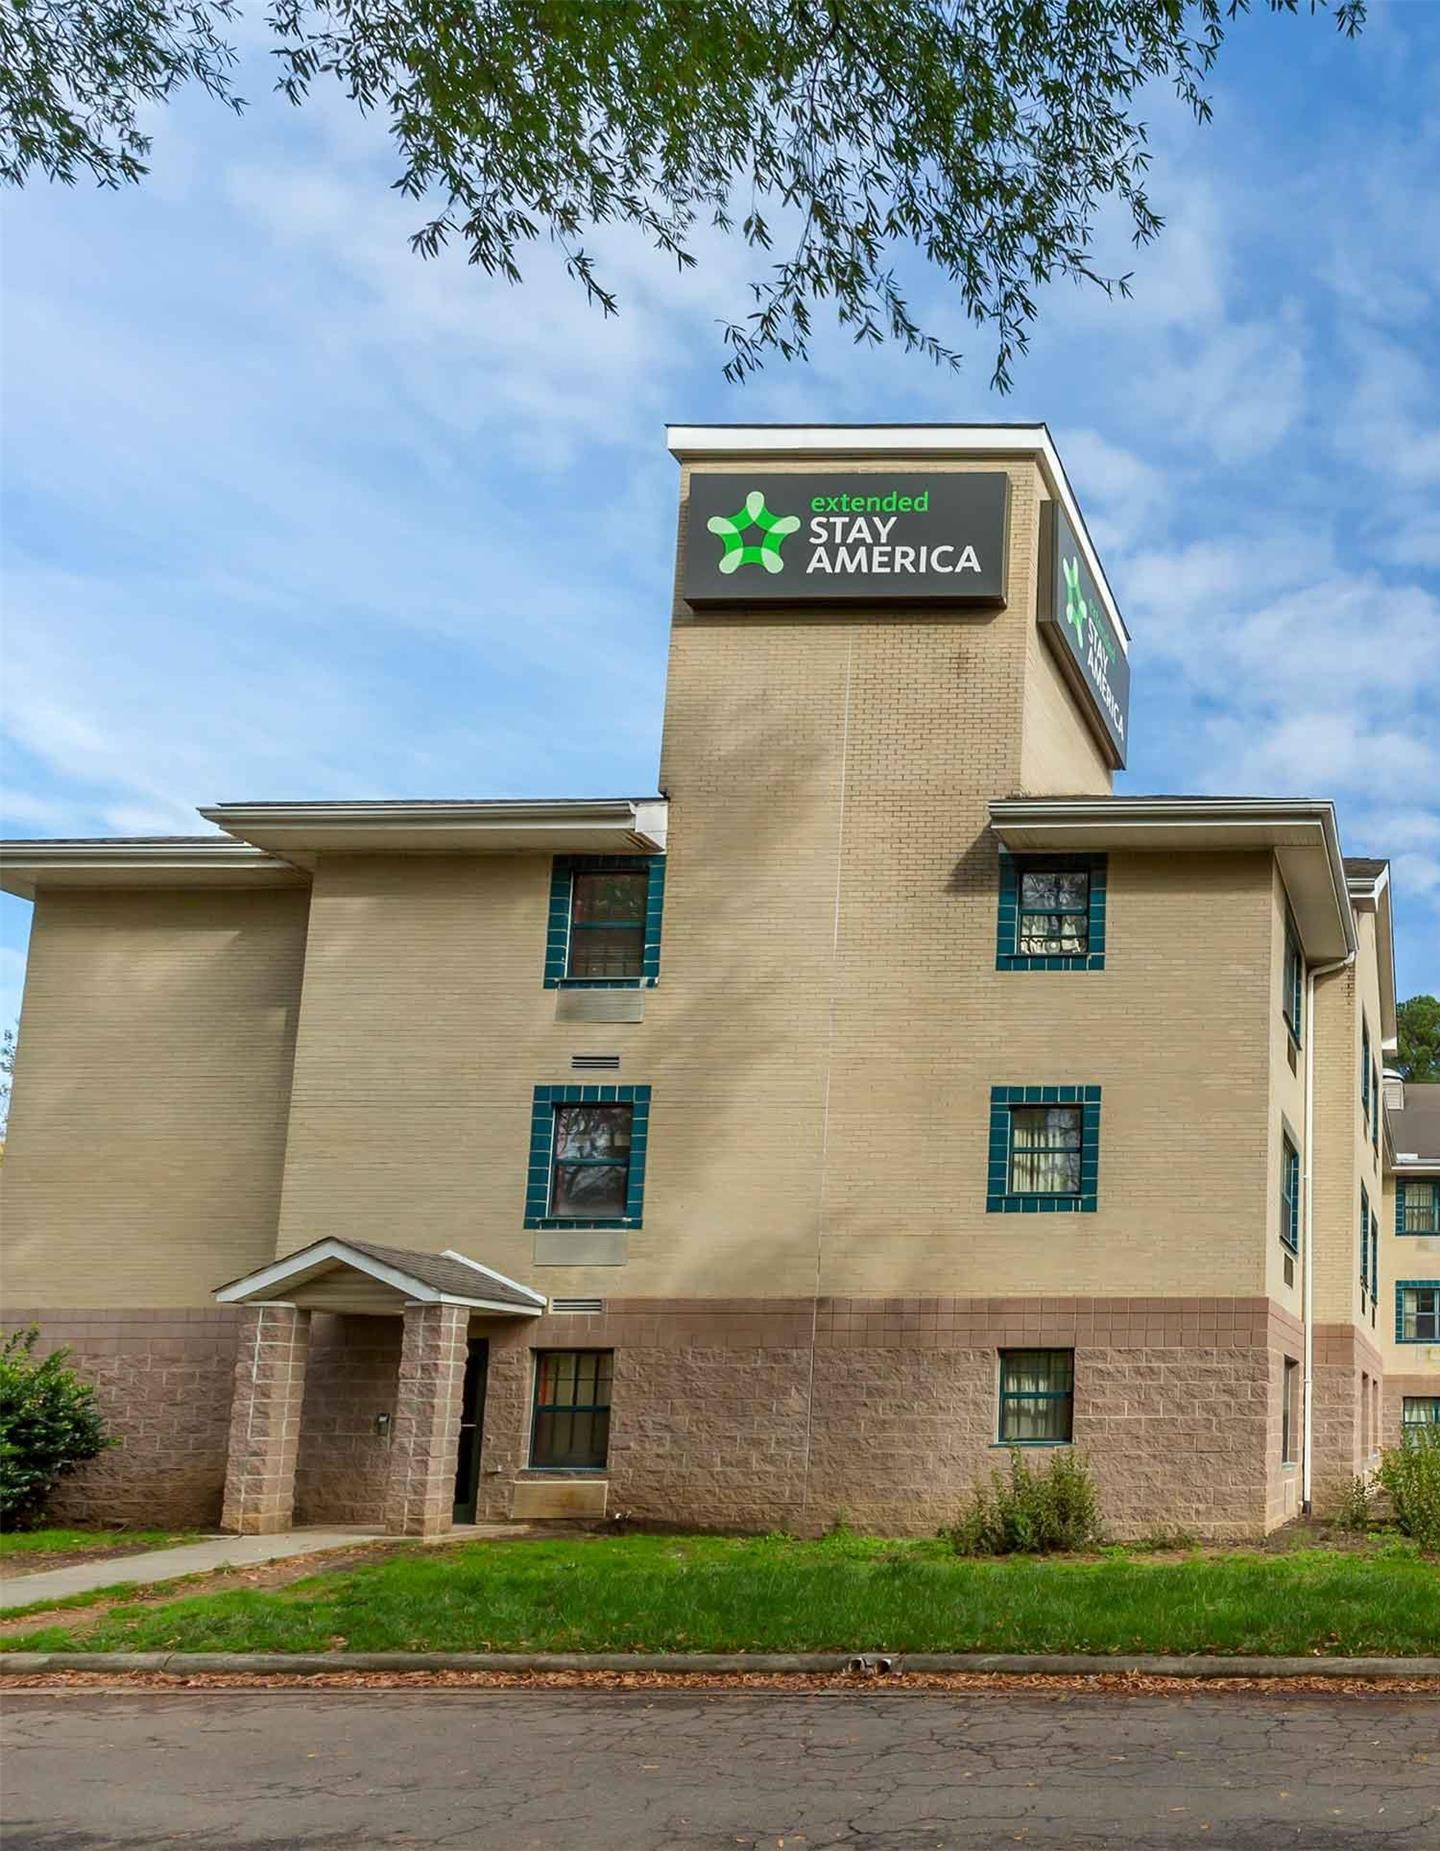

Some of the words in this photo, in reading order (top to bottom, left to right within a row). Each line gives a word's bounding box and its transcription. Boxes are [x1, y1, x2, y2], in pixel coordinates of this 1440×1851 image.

[811, 491, 929, 512] extended
[809, 516, 897, 544] STAY
[805, 545, 982, 574] AMERICA
[1087, 616, 1108, 675] STAY
